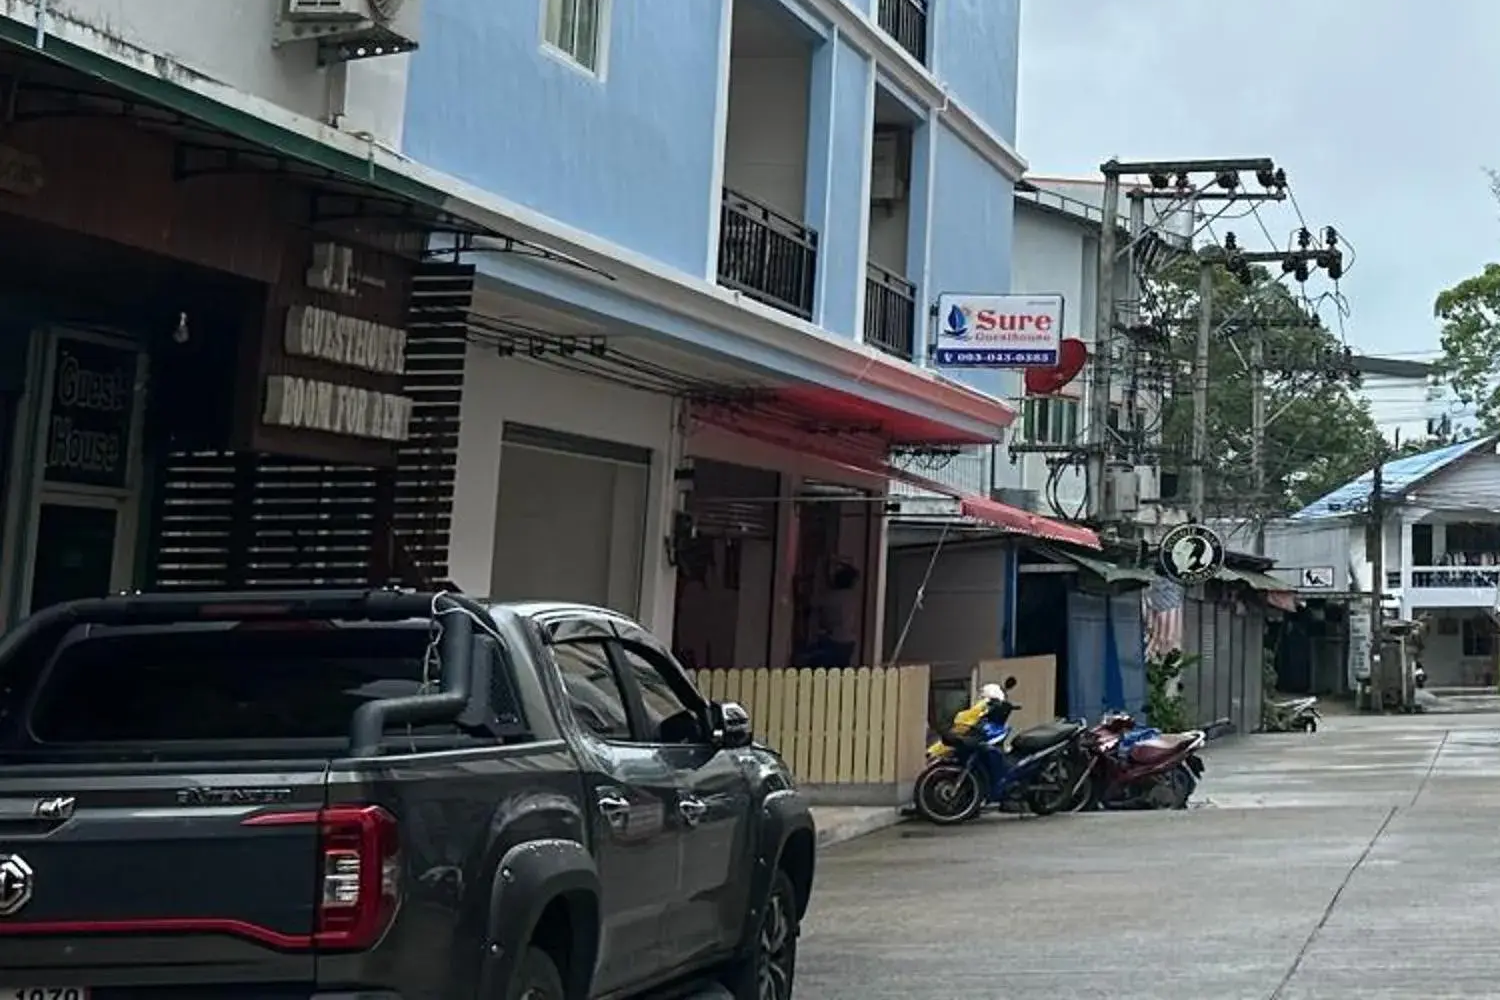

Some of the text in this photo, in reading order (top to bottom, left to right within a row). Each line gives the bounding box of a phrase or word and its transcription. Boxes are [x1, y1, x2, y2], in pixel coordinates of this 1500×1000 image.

[300, 305, 408, 375] GUESTHOUSE
[976, 310, 1053, 330] Sure
[333, 385, 368, 437] FOR
